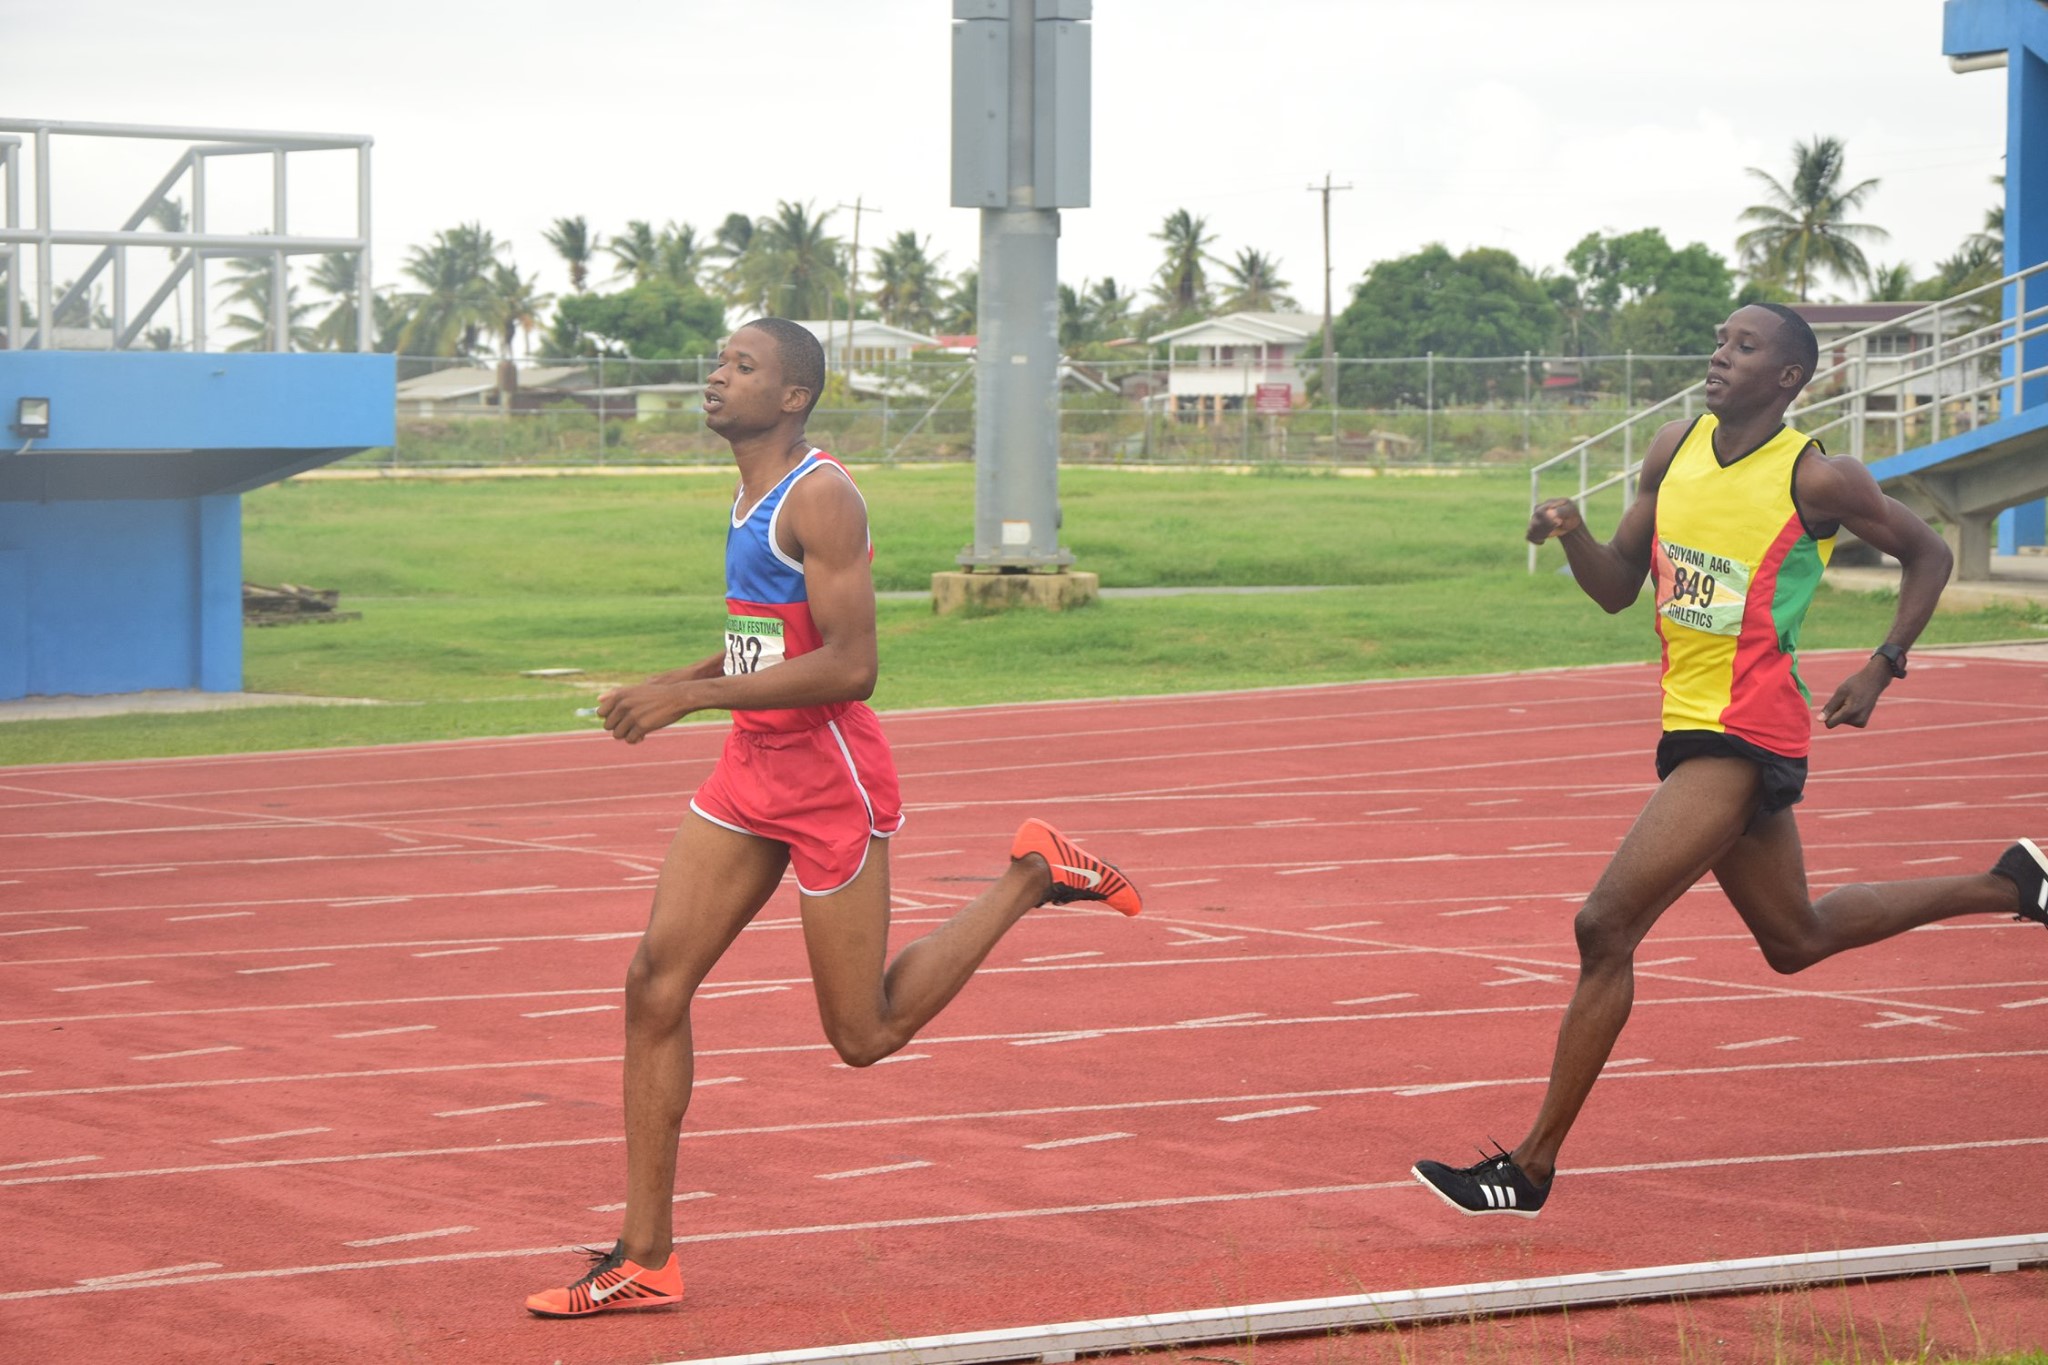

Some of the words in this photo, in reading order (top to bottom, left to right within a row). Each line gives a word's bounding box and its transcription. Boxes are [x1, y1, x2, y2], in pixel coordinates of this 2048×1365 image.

[1668, 544, 1705, 567] GUYANA
[1709, 556, 1731, 574] AAG
[1673, 567, 1715, 608] 849
[747, 620, 781, 635] FESTIVAL
[1667, 603, 1713, 628] ATHLETICS
[728, 633, 762, 674] 732
